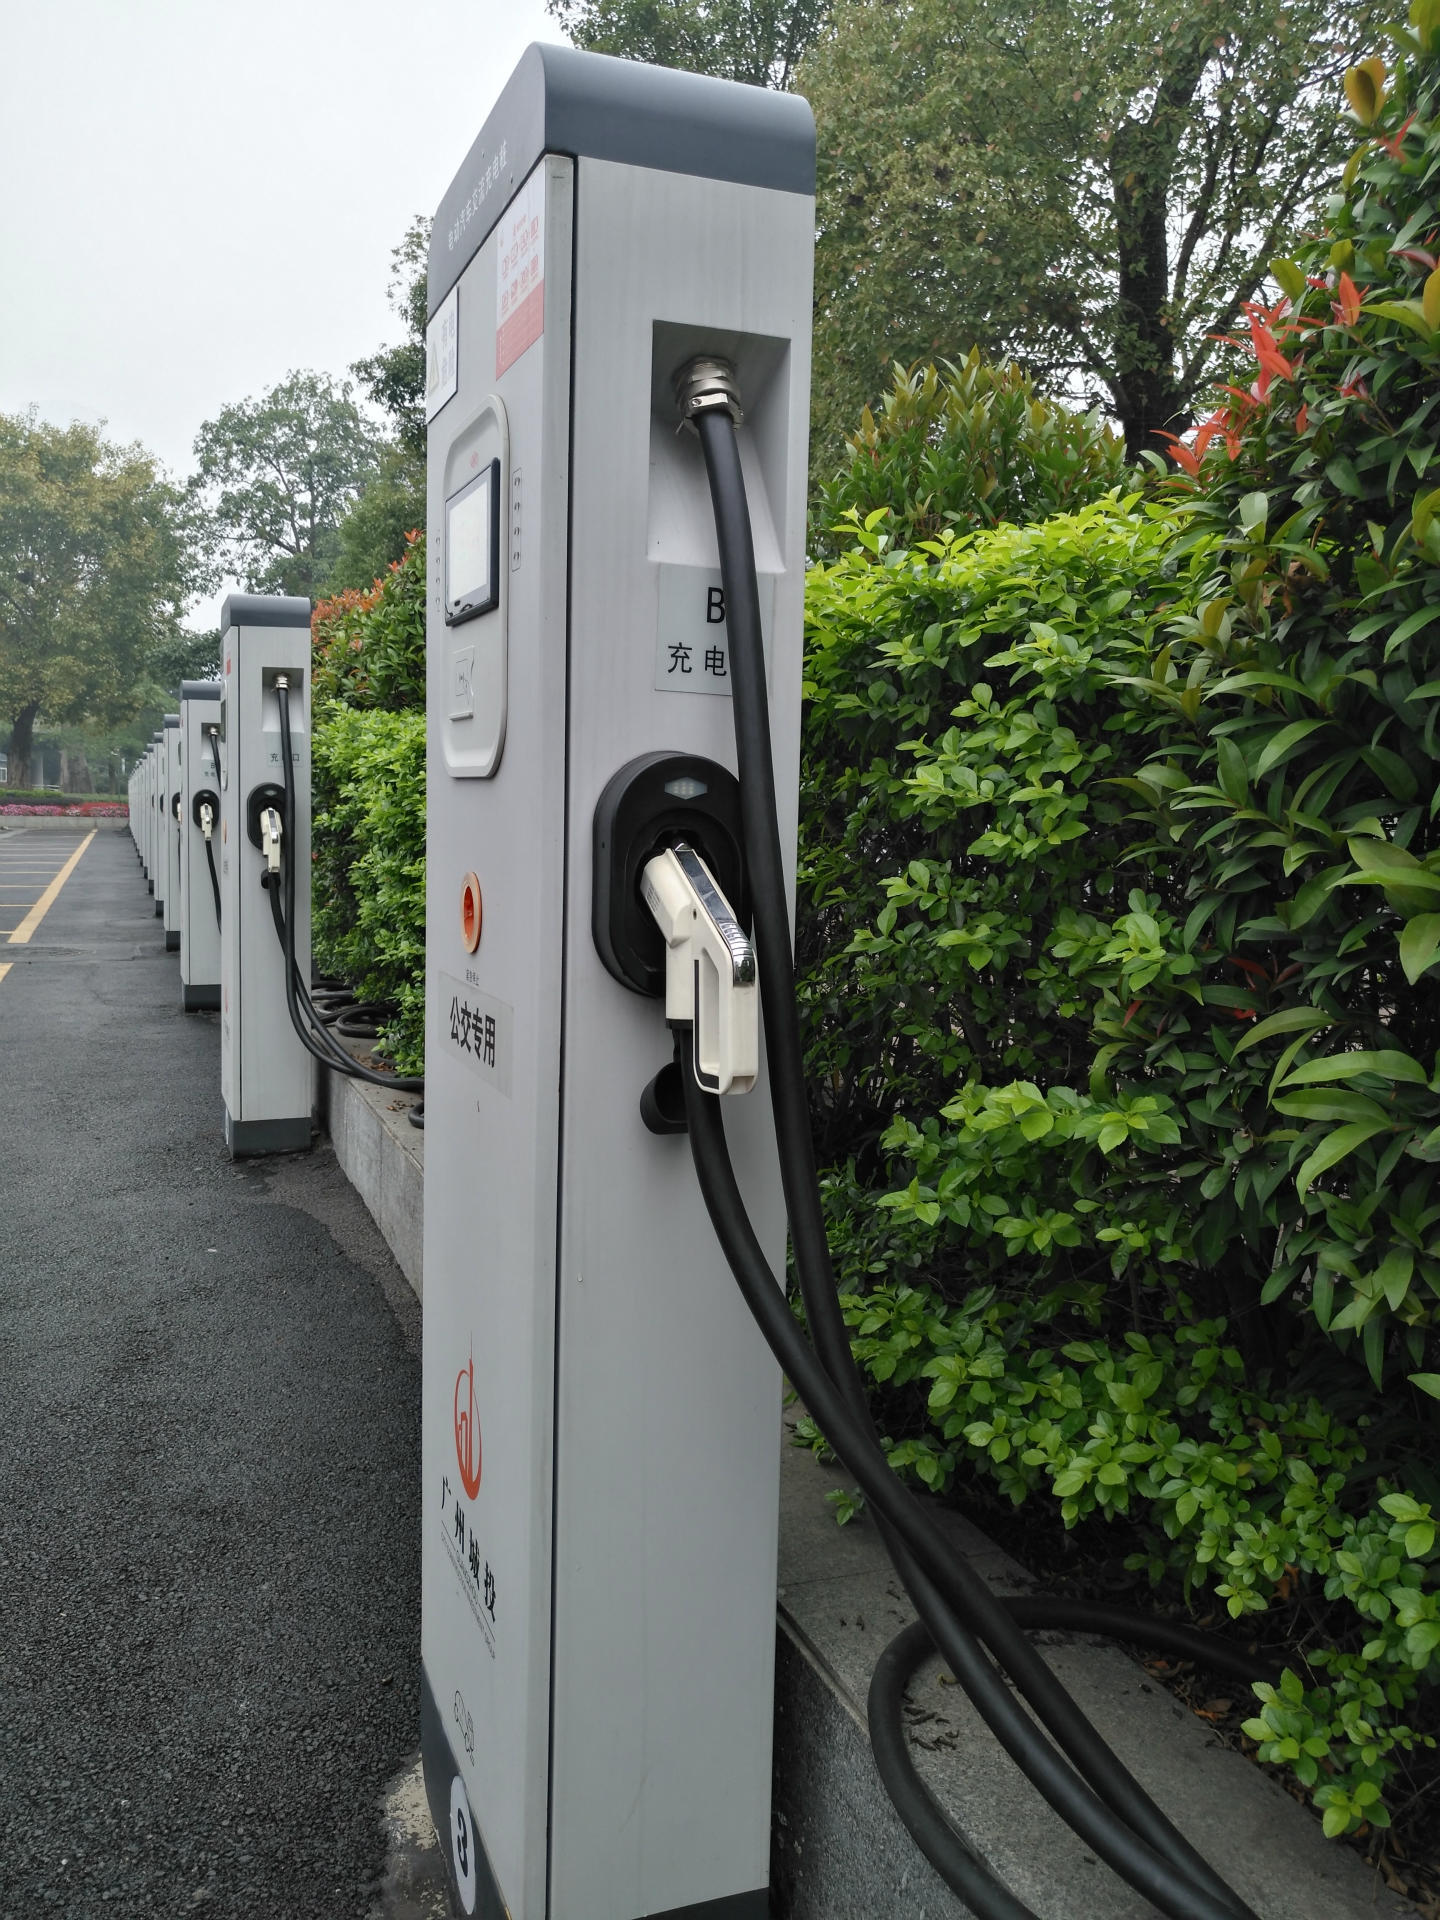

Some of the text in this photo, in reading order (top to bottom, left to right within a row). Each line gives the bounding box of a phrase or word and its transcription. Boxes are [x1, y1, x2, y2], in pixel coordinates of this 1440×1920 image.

[707, 586, 727, 624] B
[667, 641, 728, 677] 充电
[270, 752, 300, 762] 充口
[450, 995, 496, 1068] 公交专用
[441, 1475, 497, 1623] 广州城投
[457, 1807, 469, 1878] 3
